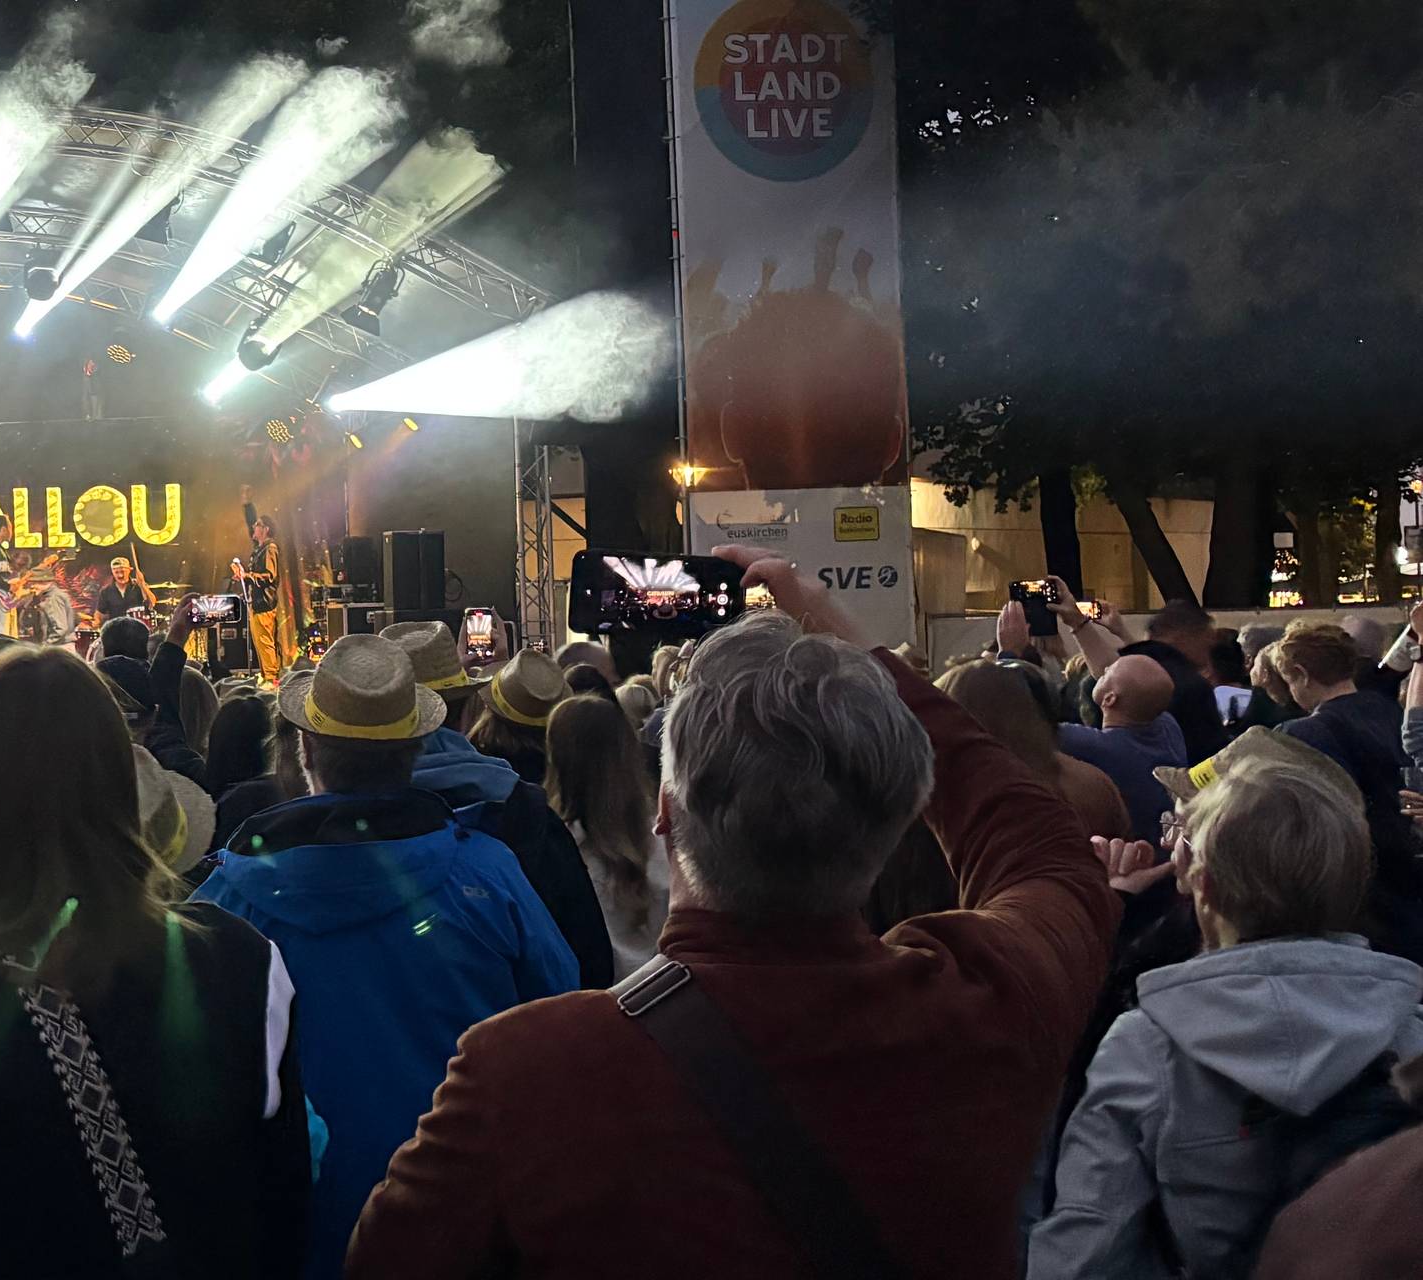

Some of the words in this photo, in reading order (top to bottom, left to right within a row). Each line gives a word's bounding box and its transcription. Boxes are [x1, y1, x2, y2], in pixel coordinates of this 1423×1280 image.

[724, 33, 848, 64] STADT
[734, 71, 841, 101] LAND
[746, 108, 833, 138] LIVE
[727, 526, 788, 539] euskirchen
[818, 566, 873, 590] SVE
